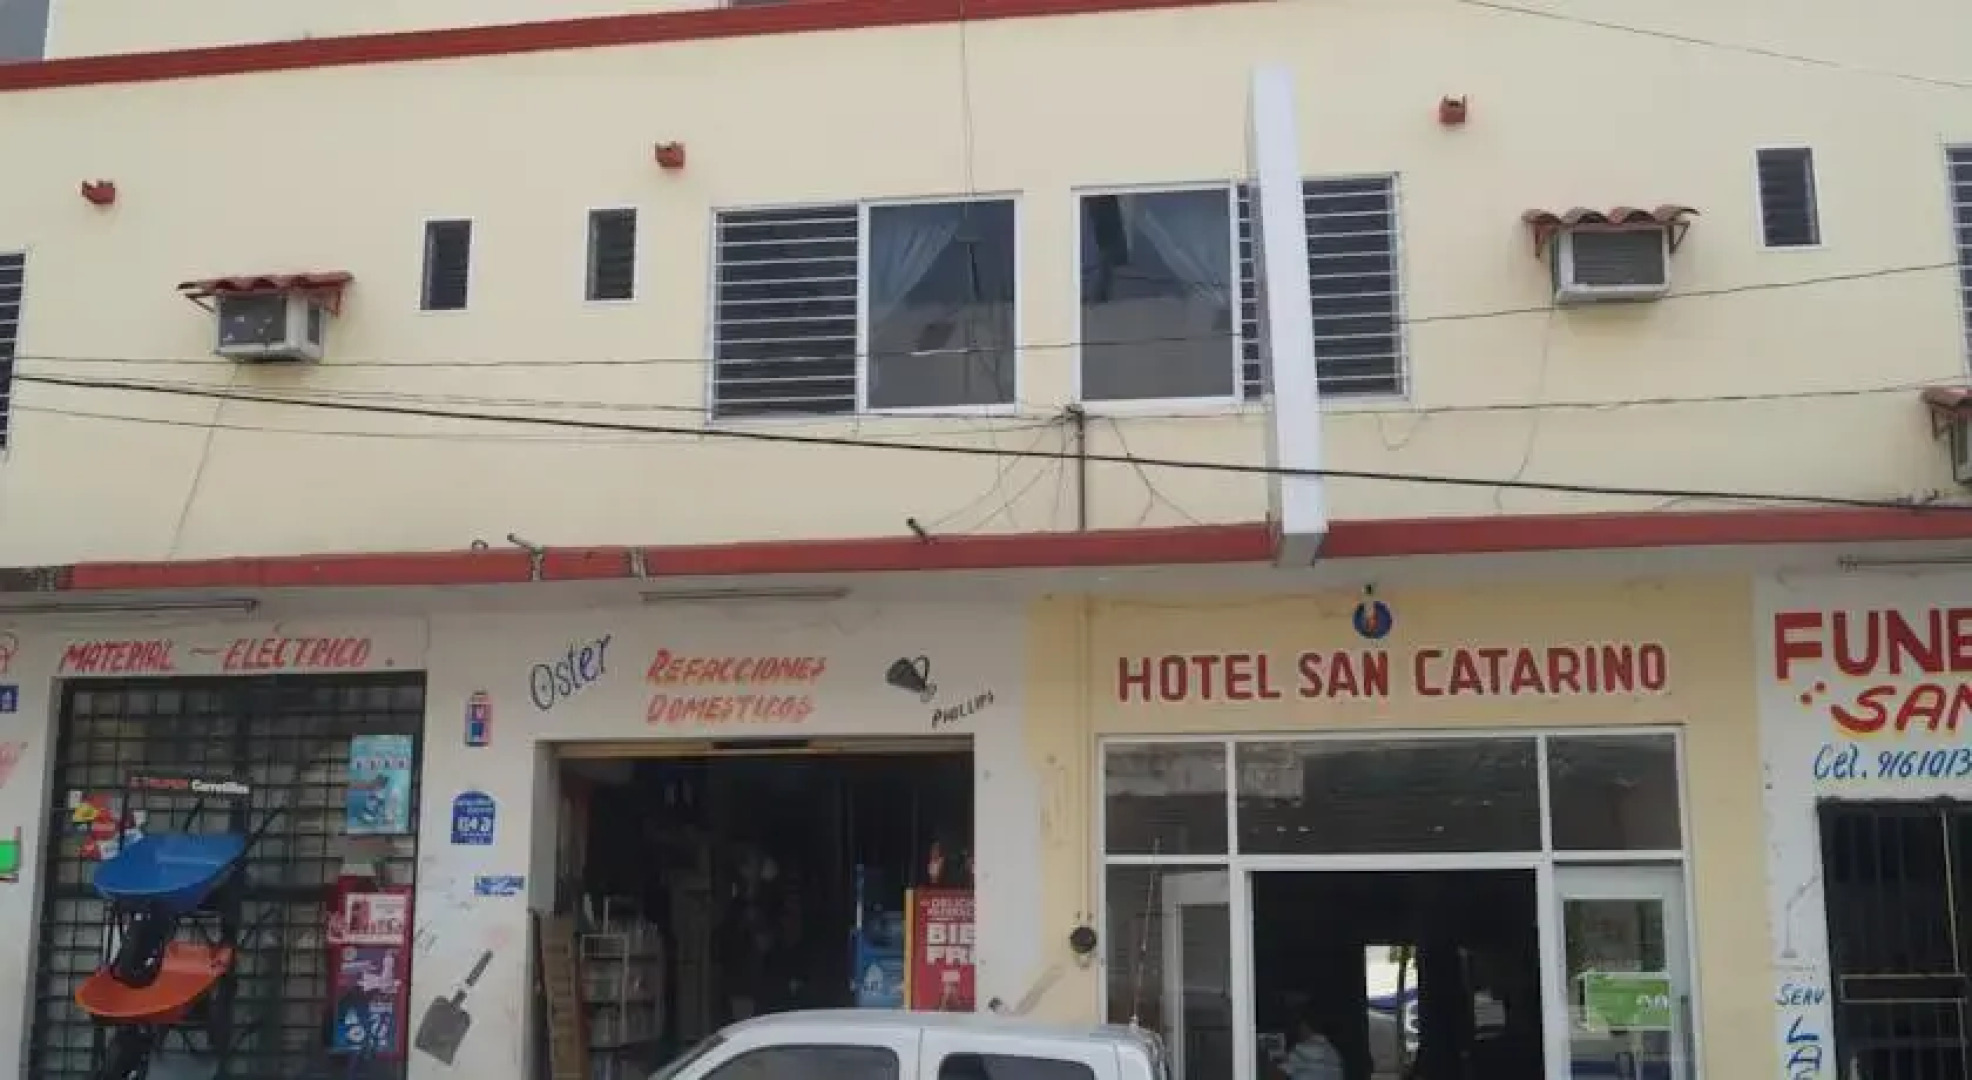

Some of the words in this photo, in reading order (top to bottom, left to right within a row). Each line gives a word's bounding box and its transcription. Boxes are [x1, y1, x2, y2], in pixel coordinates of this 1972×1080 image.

[59, 638, 177, 672] MATERIAL
[530, 634, 611, 711] Oster
[1119, 653, 1281, 702] HOTEL
[1299, 650, 1389, 699] SAN
[1414, 643, 1666, 697] CATARINO
